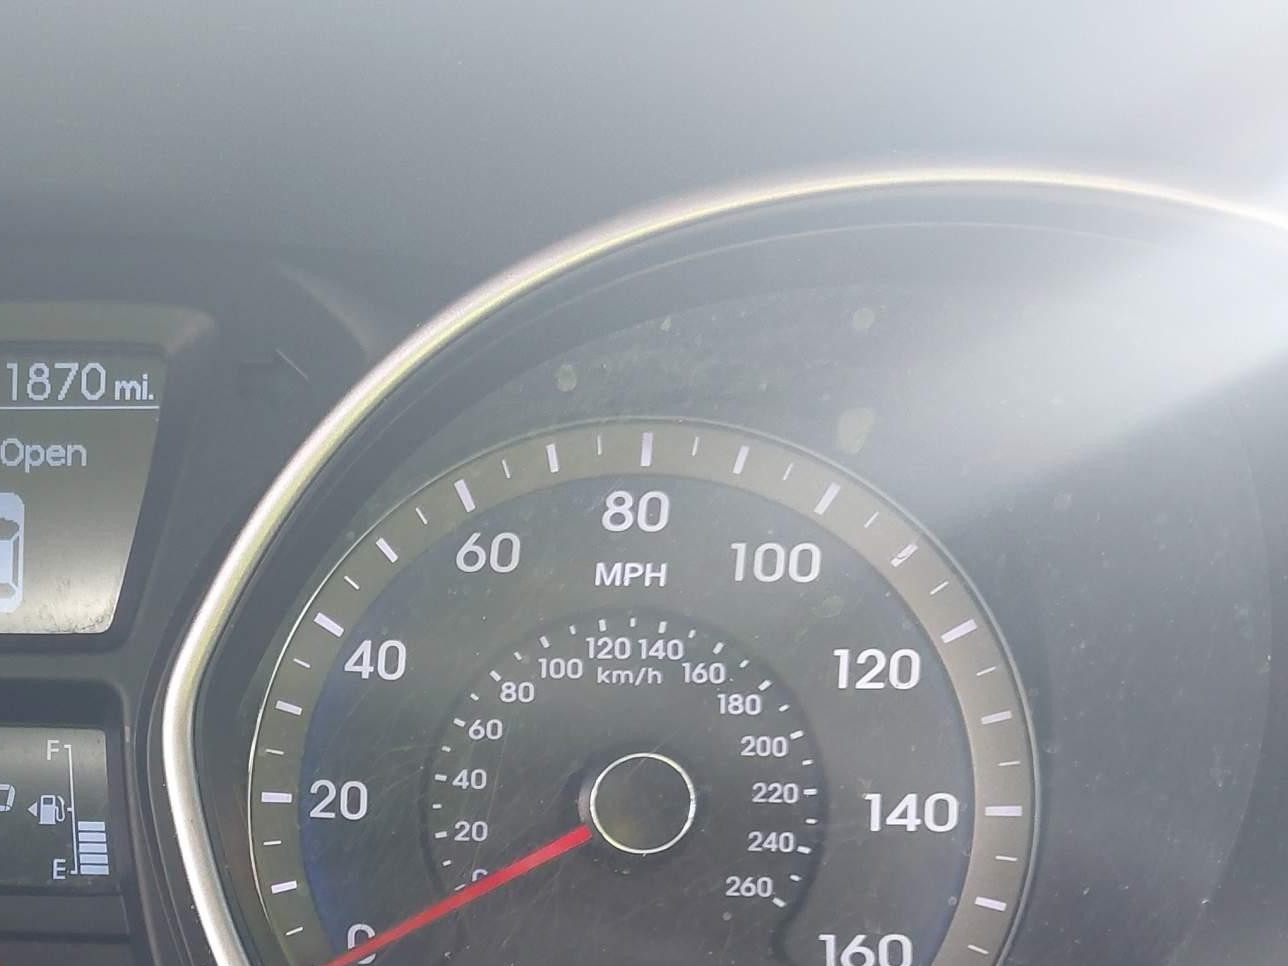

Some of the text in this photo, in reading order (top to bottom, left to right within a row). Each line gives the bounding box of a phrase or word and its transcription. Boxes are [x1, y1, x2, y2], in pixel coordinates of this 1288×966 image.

[114, 374, 154, 401] mi.
[0, 437, 87, 473] Open
[601, 490, 670, 532] 80
[455, 532, 521, 574] 60
[729, 541, 822, 584] 100
[594, 562, 668, 588] MPH
[585, 636, 632, 660] 120
[637, 638, 684, 661] 140
[343, 639, 407, 681] 40
[537, 657, 584, 680] 100
[832, 647, 922, 690] 120
[596, 665, 663, 686] km/h
[681, 661, 727, 684] 160
[499, 681, 536, 704] 80
[717, 693, 762, 716] 180
[468, 718, 504, 741] 60
[47, 739, 60, 761] F
[740, 735, 788, 758] 200
[452, 768, 487, 791] 40
[309, 778, 369, 820] 20
[751, 782, 798, 804] 220
[863, 792, 960, 833] 140
[454, 820, 489, 843] 20
[747, 831, 795, 853] 240
[52, 858, 67, 880] E
[725, 876, 773, 899] 260
